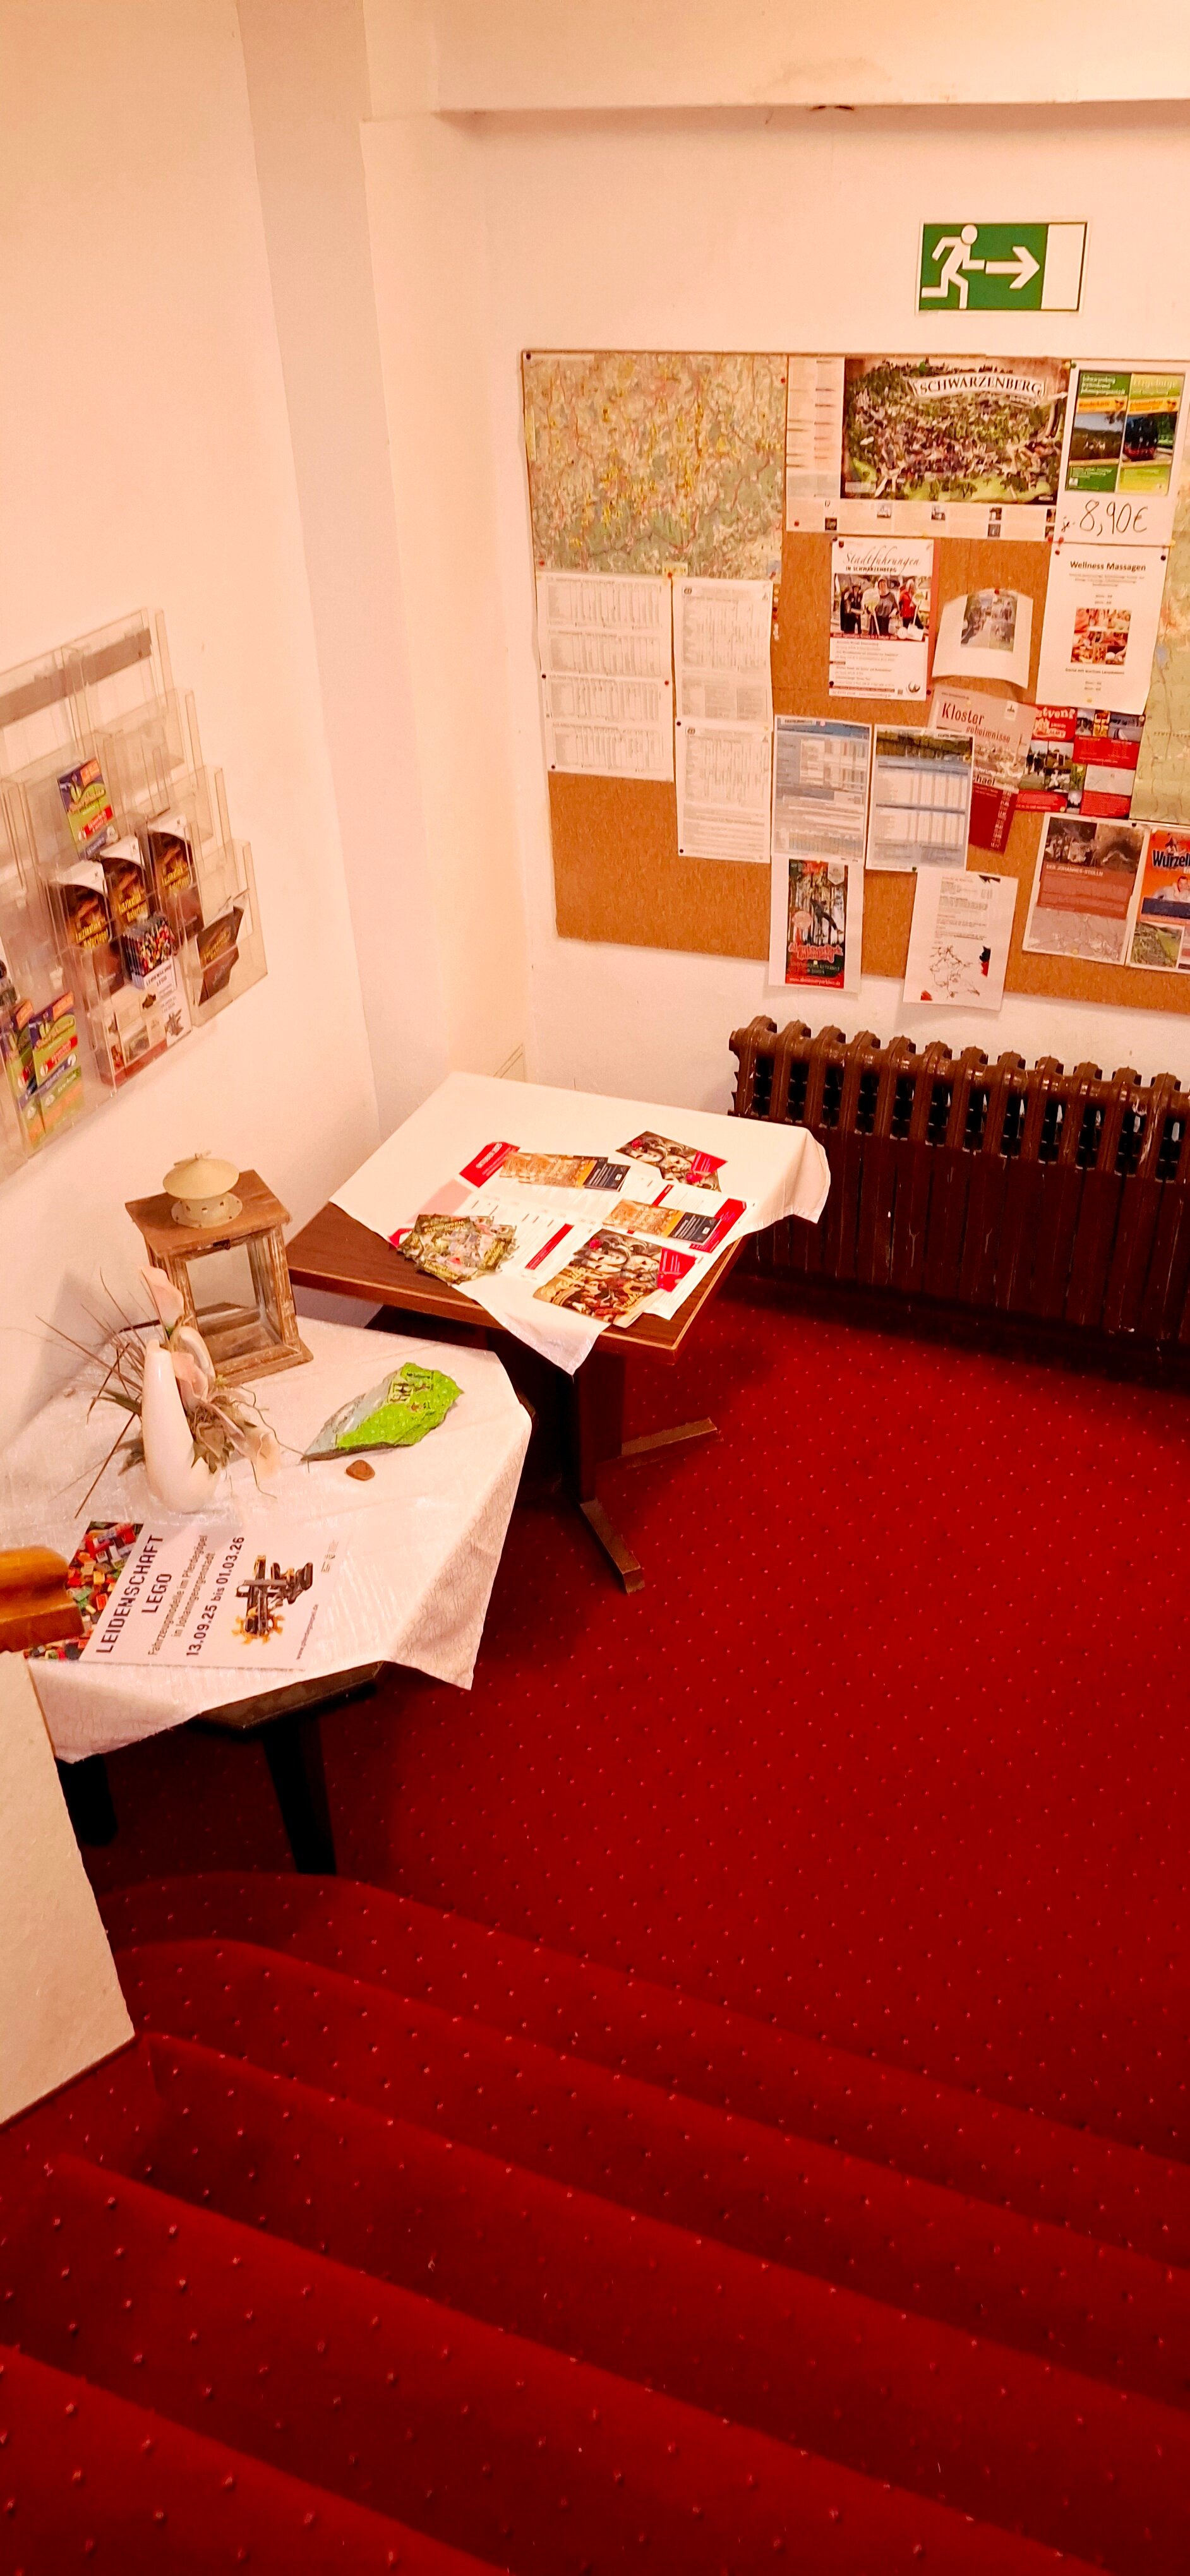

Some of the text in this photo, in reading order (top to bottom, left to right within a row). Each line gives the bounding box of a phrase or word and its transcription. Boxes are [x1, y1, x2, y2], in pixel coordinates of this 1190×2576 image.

[920, 376, 1042, 395] SCHWARZENBERG
[843, 546, 920, 573] Stadtführungen
[1070, 561, 1146, 572] Wellness Massagen
[942, 702, 985, 725] Kloster
[1153, 849, 1190, 868] Wurzel
[96, 1535, 163, 1653] LEIDENSCHAFT
[141, 1573, 172, 1613] LEGO
[176, 1553, 215, 1628] Johanngeorgenstadt
[186, 1537, 245, 1656] 13.09.25 bis 01.03.26
[148, 1590, 184, 1655] Fahrzeugmodelle
